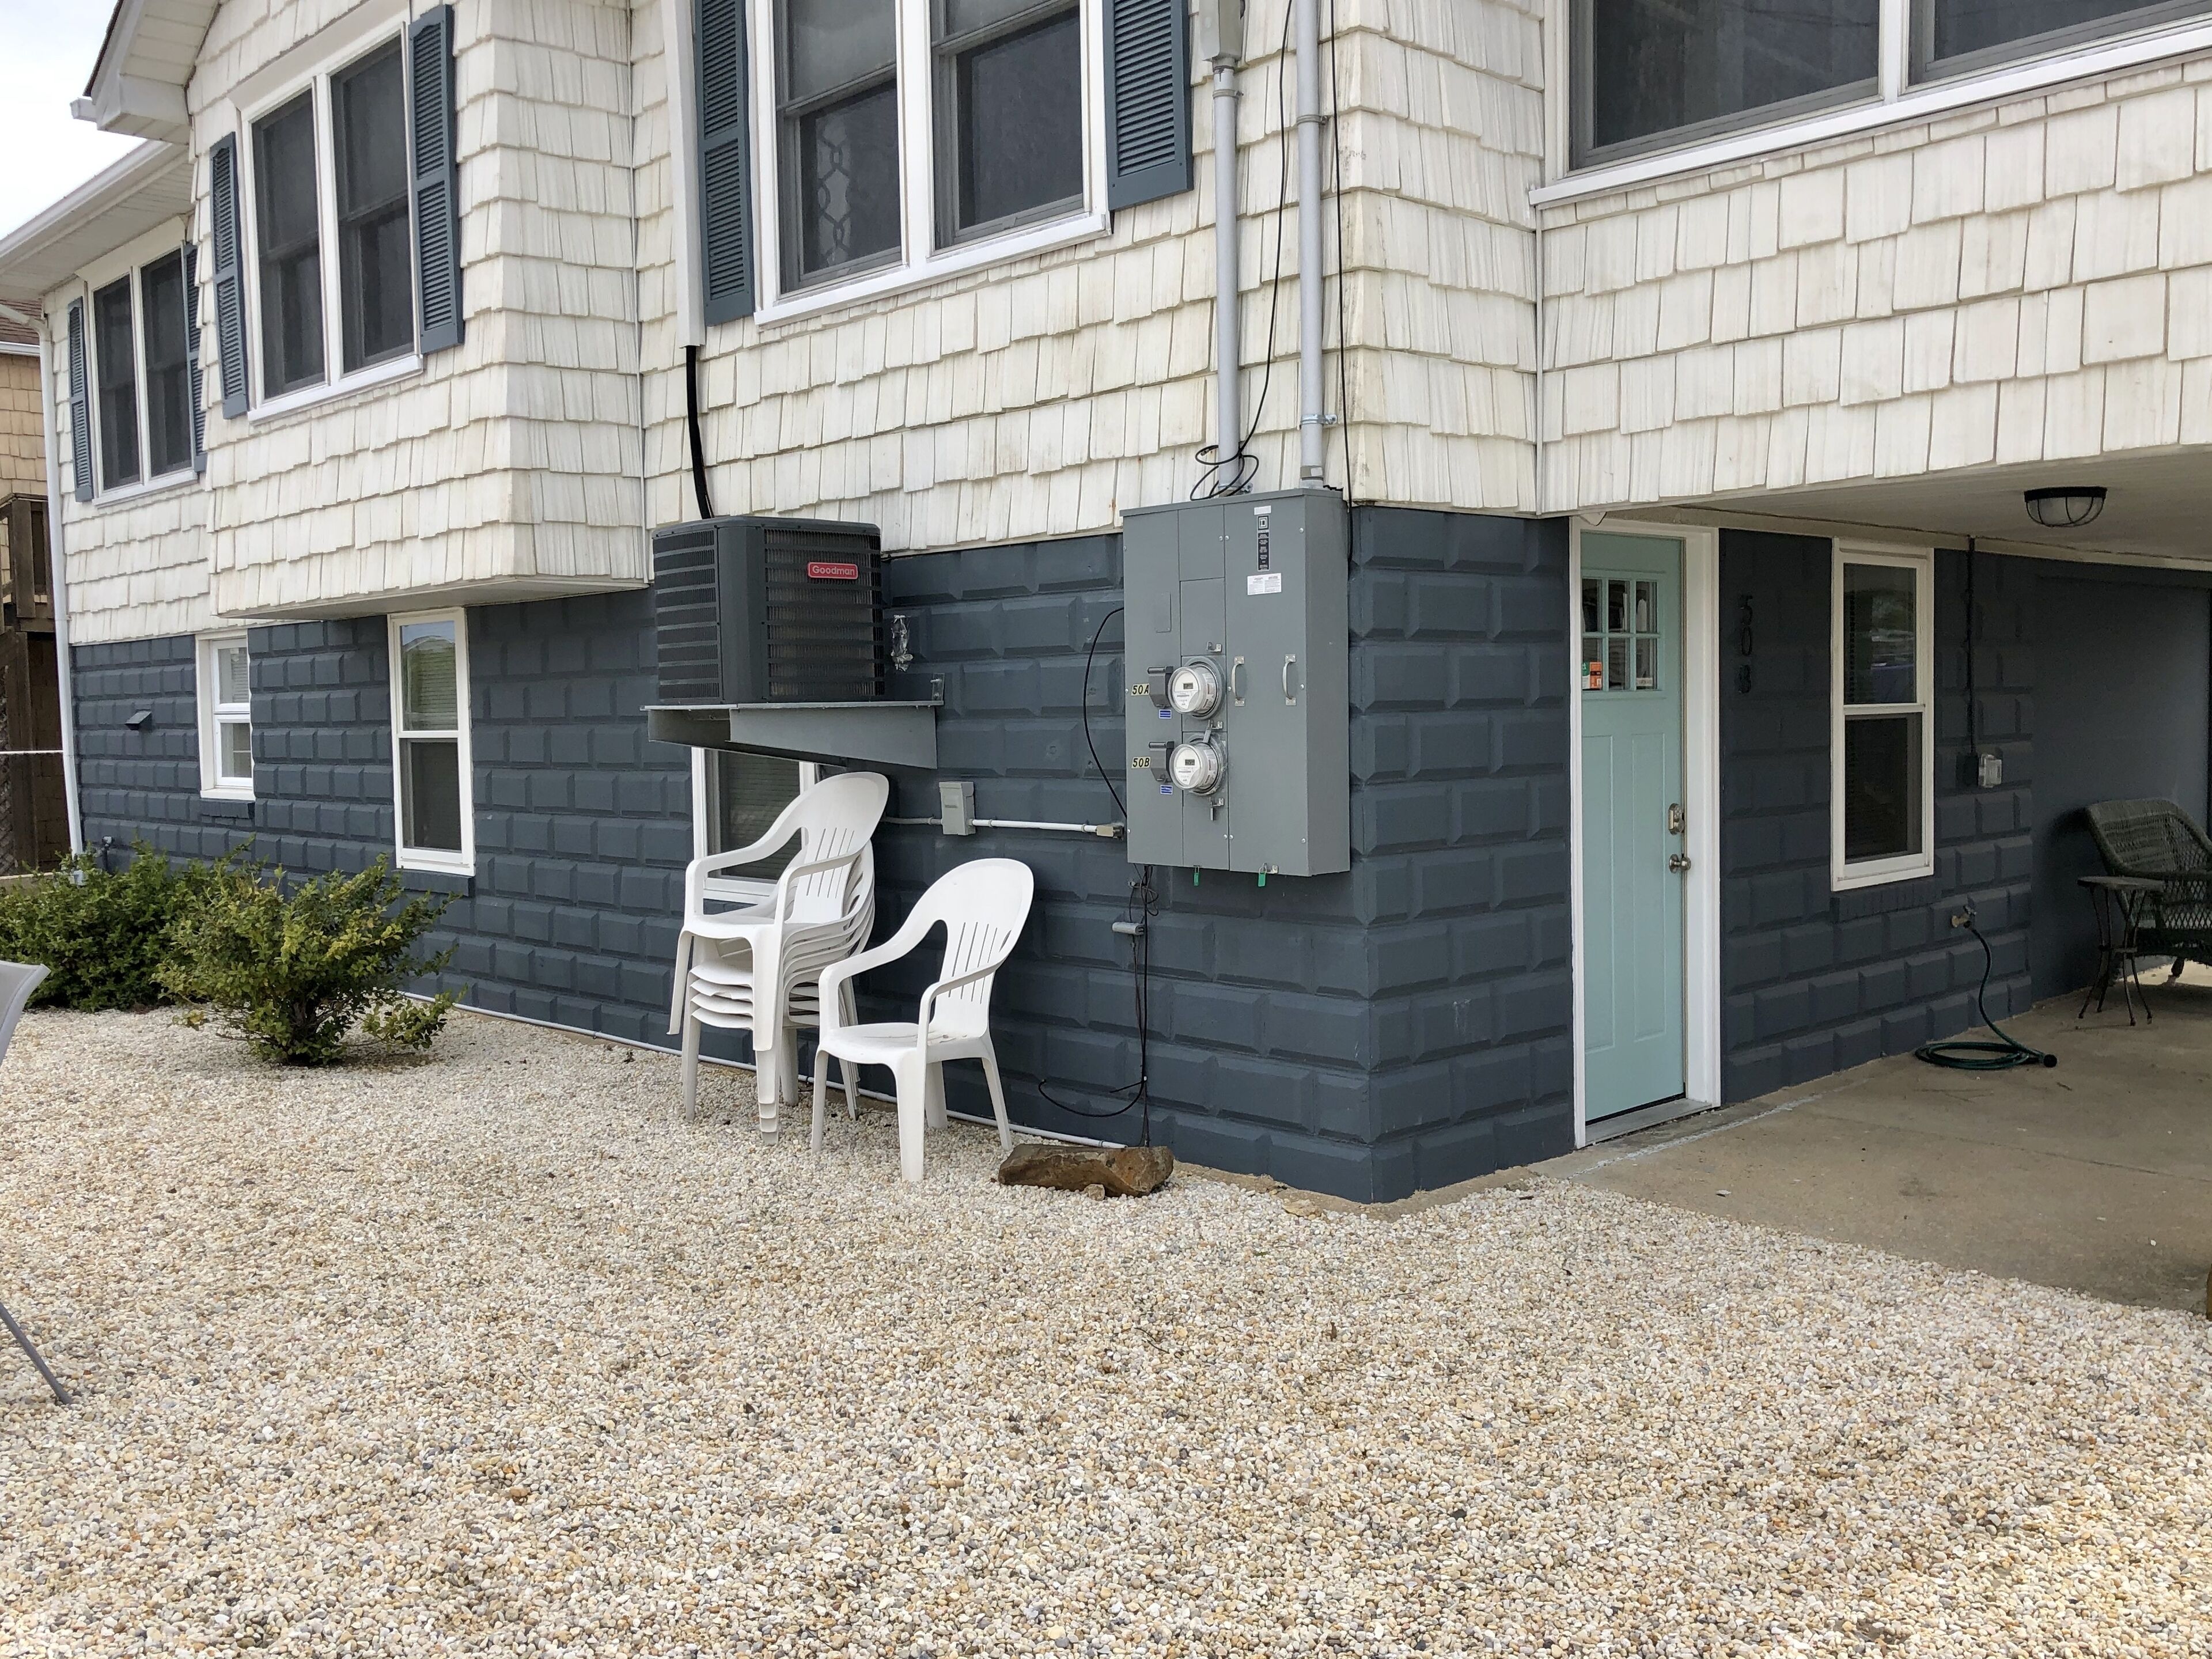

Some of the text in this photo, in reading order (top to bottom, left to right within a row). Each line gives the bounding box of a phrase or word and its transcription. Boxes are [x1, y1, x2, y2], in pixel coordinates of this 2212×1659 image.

[812, 565, 855, 575] Goodman
[1132, 685, 1149, 695] 50A
[1132, 757, 1150, 767] 50B
